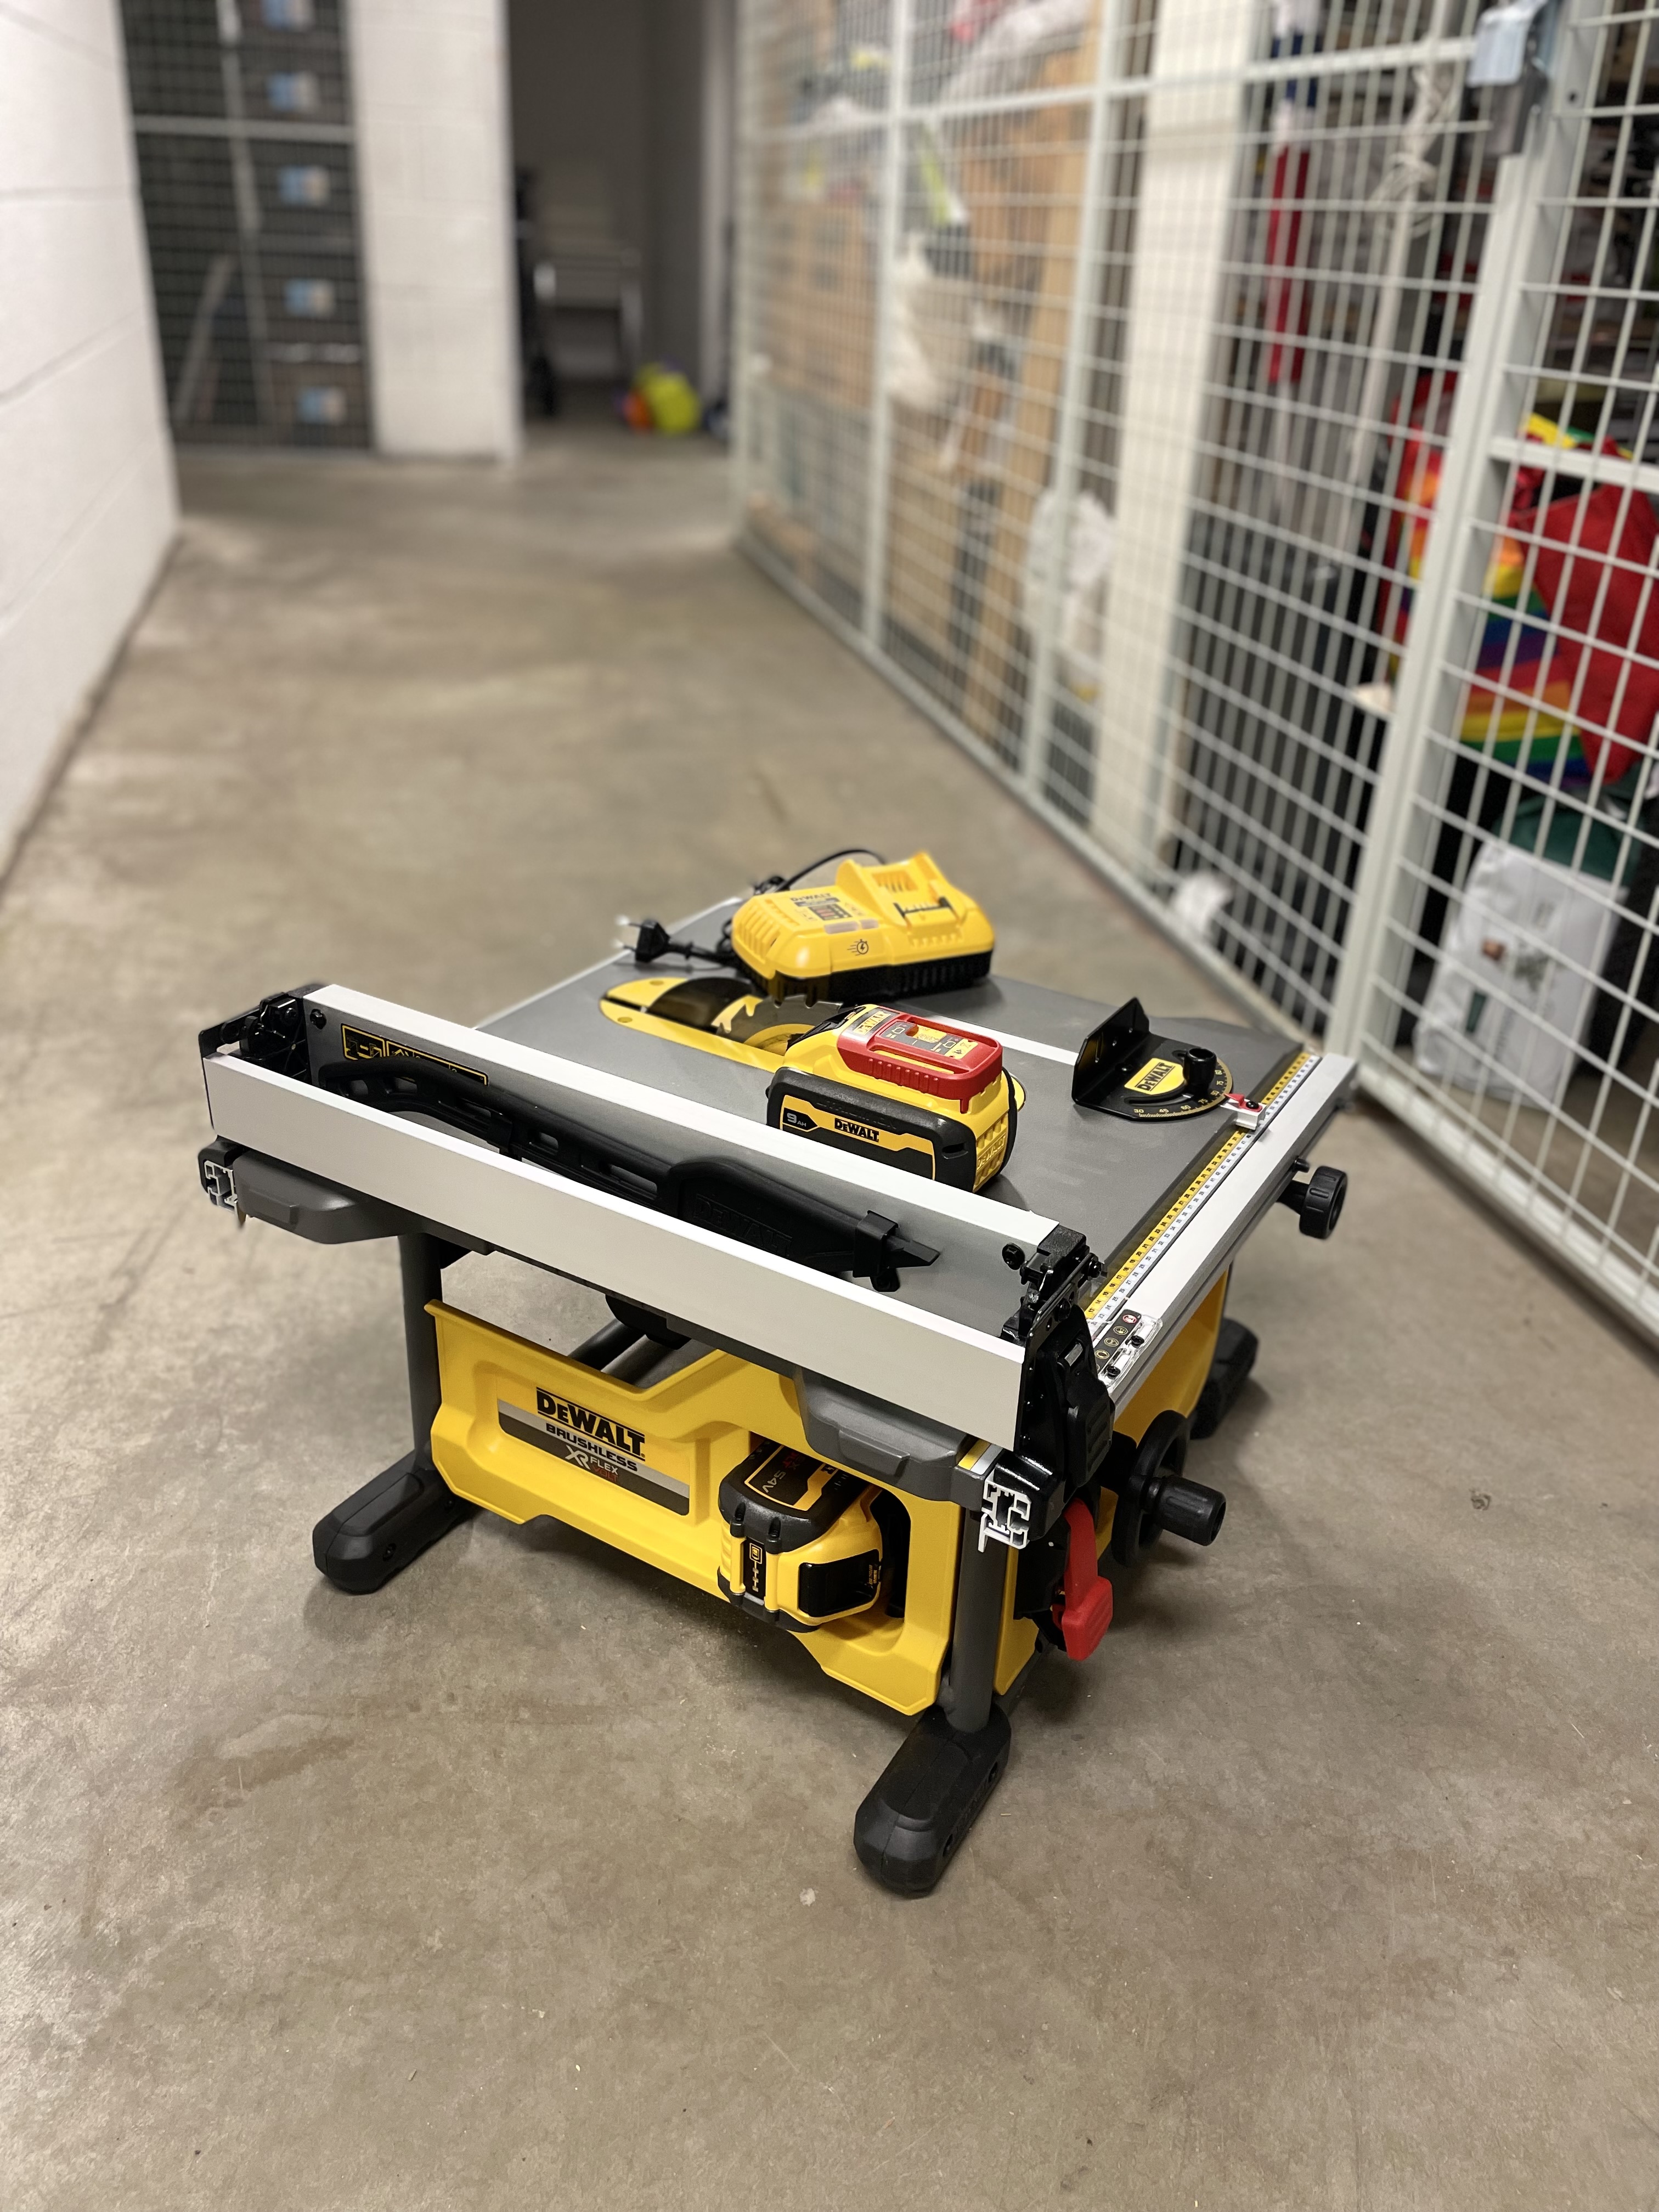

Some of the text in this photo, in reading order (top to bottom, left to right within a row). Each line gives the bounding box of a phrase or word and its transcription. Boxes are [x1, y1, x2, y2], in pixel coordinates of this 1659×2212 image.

[1137, 1063, 1173, 1091] DEWALT
[787, 1112, 797, 1124] 9
[834, 1118, 879, 1143] DEWALT
[537, 1388, 646, 1459] DEWALT
[546, 1423, 638, 1472] BRUSHLESS
[565, 1444, 618, 1475] XR FLEX
[591, 1465, 618, 1482] VOLT
[762, 1470, 786, 1493] 54V
